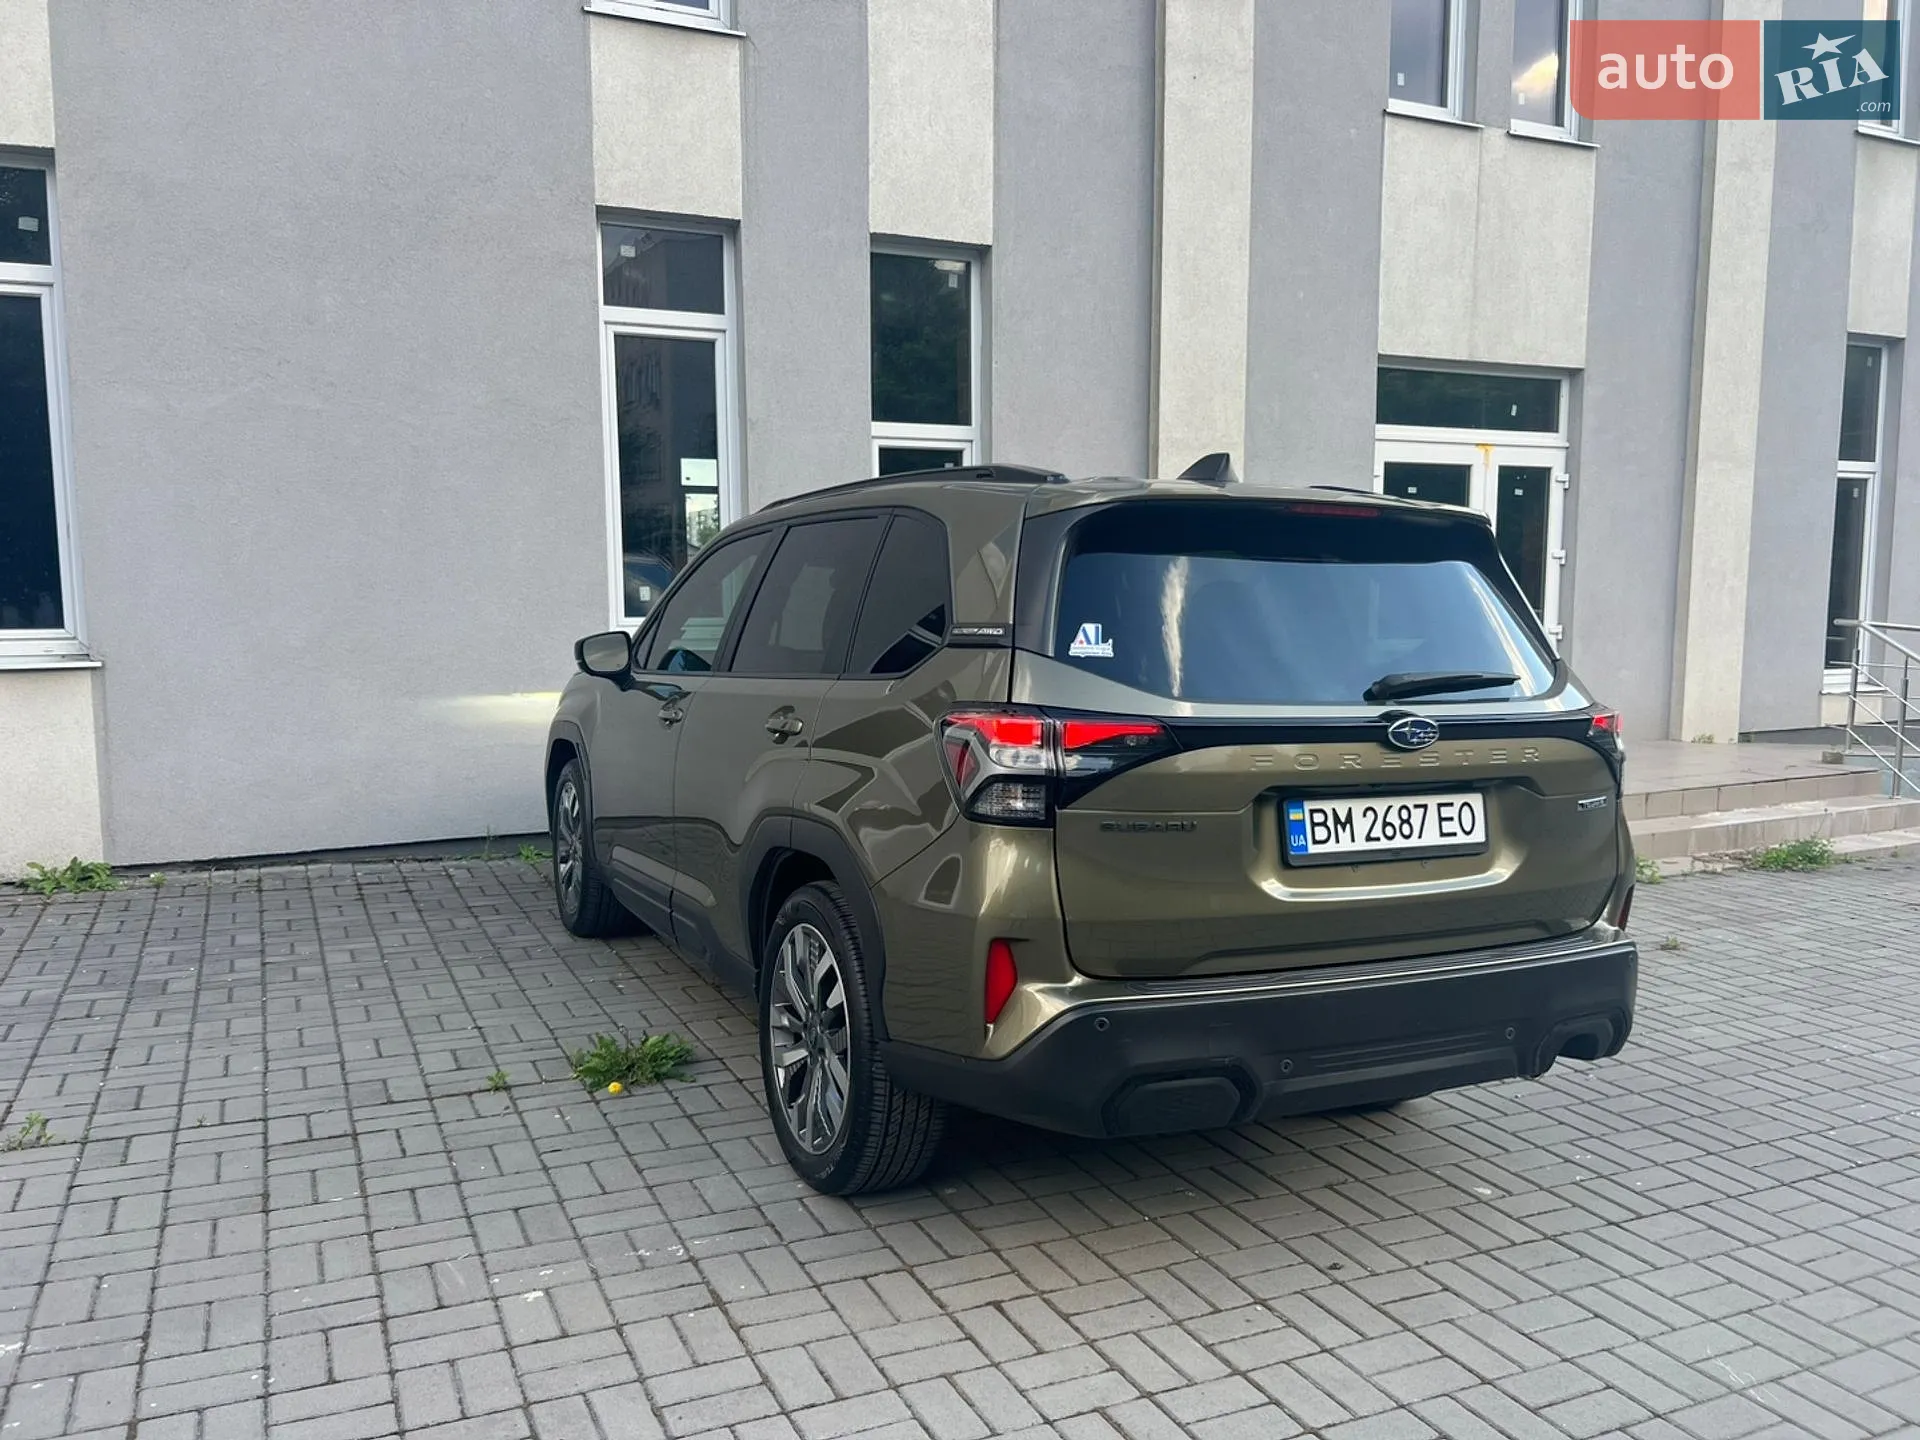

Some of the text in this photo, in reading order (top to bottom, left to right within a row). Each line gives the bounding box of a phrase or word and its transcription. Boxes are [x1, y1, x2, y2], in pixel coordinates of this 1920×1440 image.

[1251, 746, 1541, 770] FORESTER
[1100, 820, 1198, 833] SUBARU
[1309, 801, 1476, 846] BM 2687 EO
[1290, 834, 1307, 848] UA
